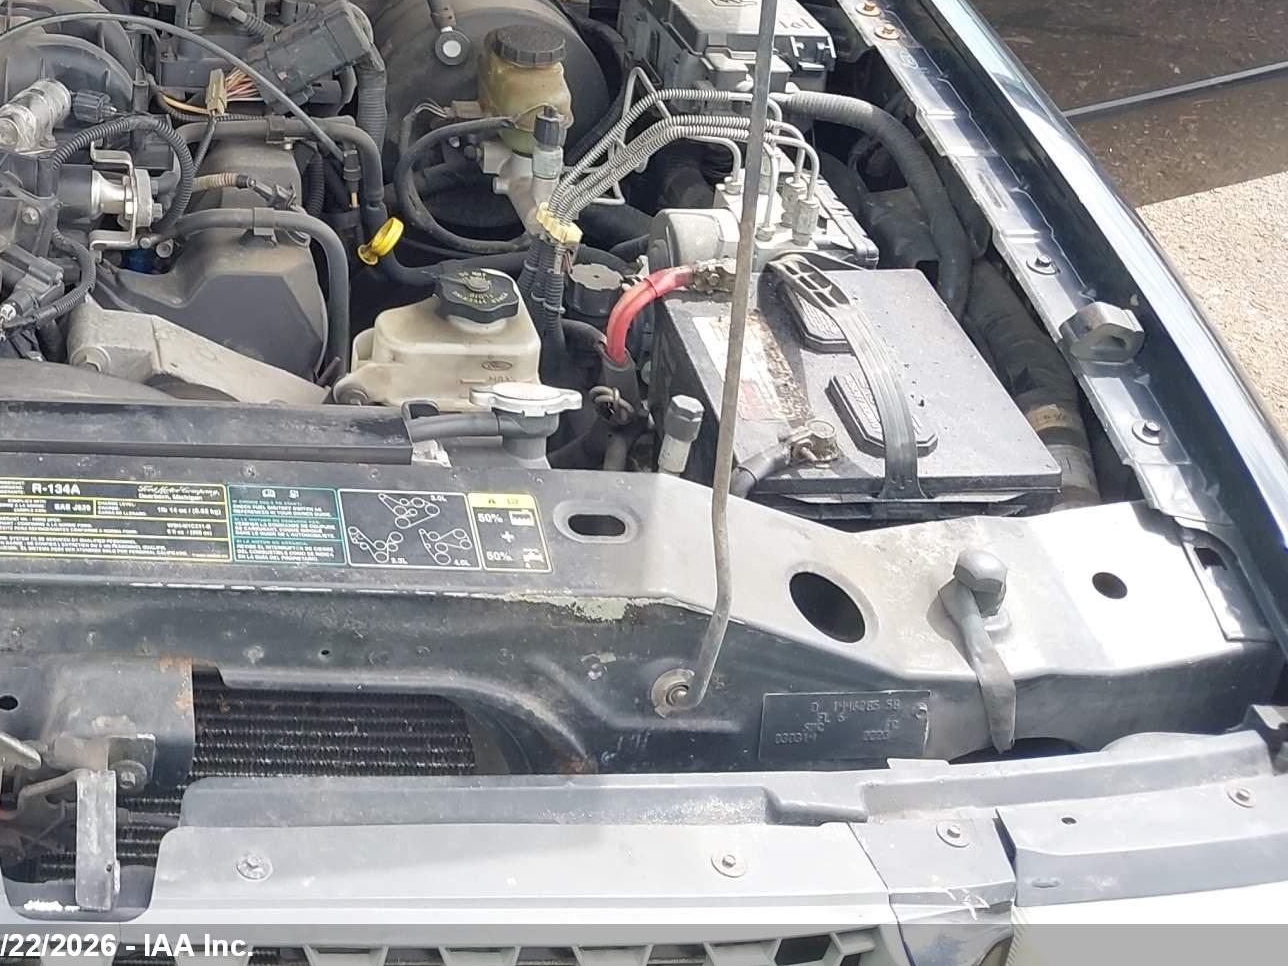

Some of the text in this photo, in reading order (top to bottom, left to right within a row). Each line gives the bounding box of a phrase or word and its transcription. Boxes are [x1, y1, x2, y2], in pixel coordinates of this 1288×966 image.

[32, 483, 80, 494] R-134A
[478, 513, 504, 523] 50%
[486, 552, 512, 561] 50%
